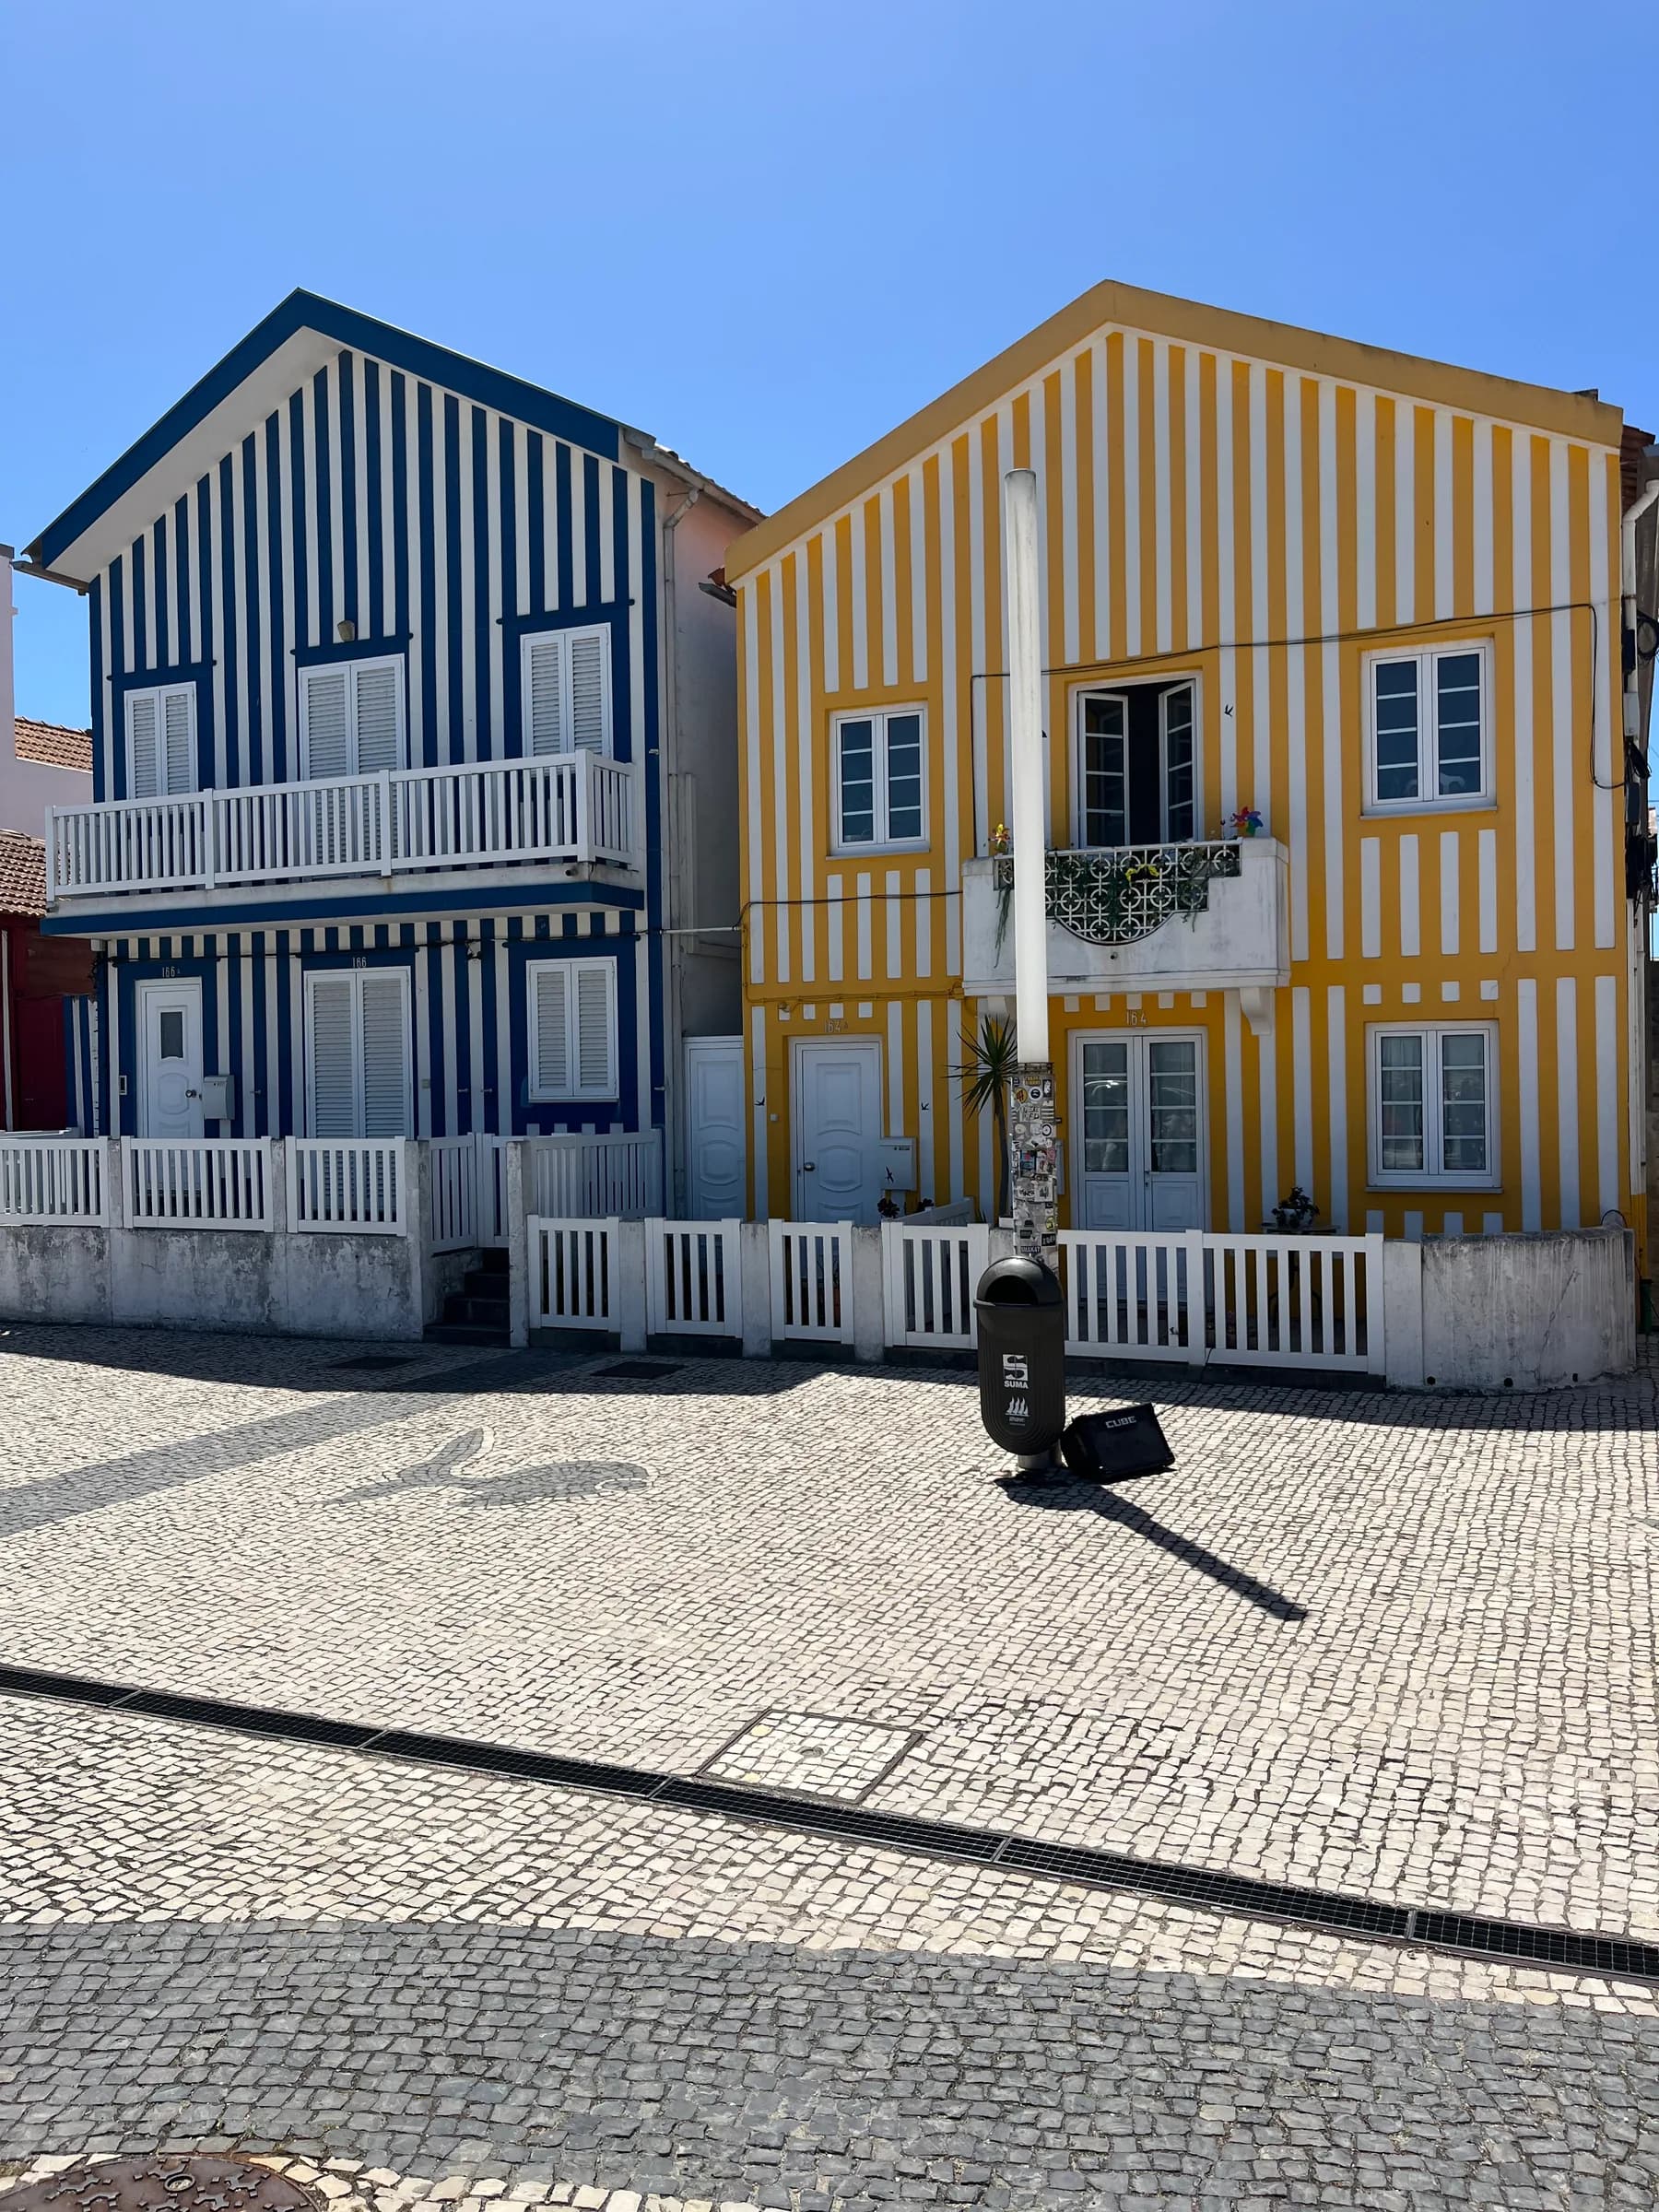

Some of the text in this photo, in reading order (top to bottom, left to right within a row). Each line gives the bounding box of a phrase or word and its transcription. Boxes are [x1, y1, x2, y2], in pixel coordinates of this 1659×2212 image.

[352, 957, 367, 968] 166
[1127, 1010, 1147, 1025] 164
[1004, 1380, 1030, 1389] SUMA
[1105, 1416, 1136, 1429] CUBE
